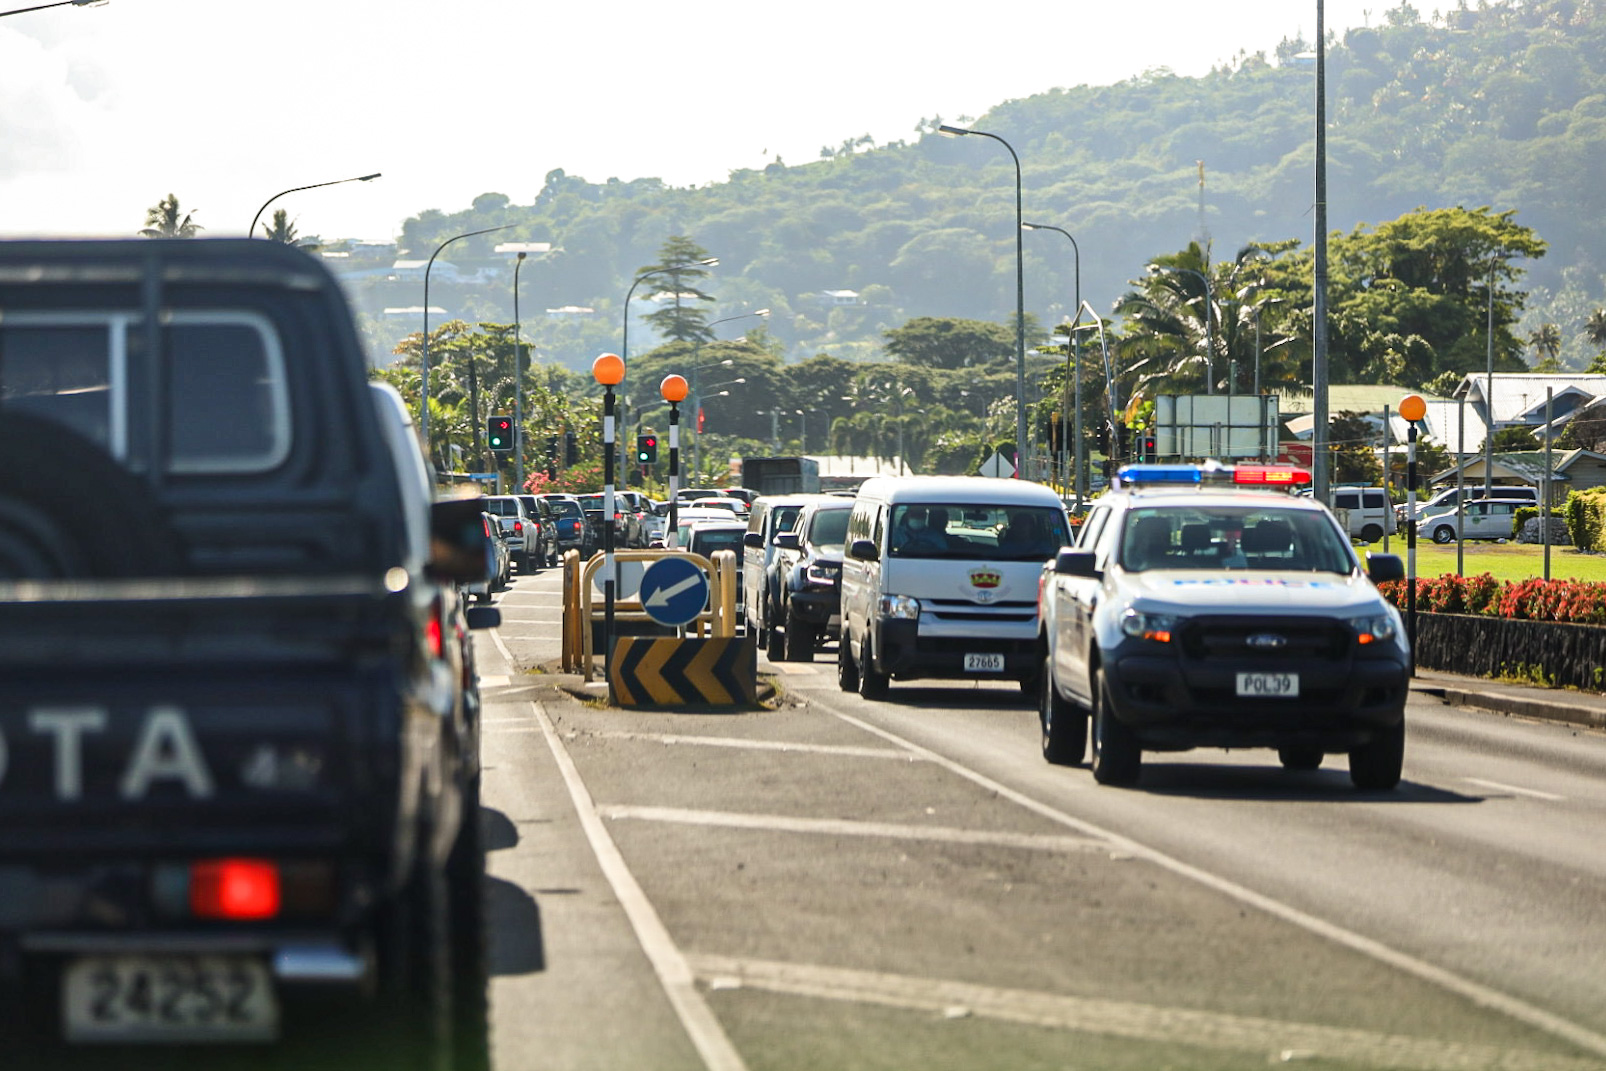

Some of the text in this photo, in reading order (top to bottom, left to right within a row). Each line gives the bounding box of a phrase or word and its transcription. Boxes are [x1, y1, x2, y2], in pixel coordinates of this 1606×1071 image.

[969, 656, 1000, 668] 27665
[1244, 677, 1291, 692] POL39
[0, 706, 214, 800] TA
